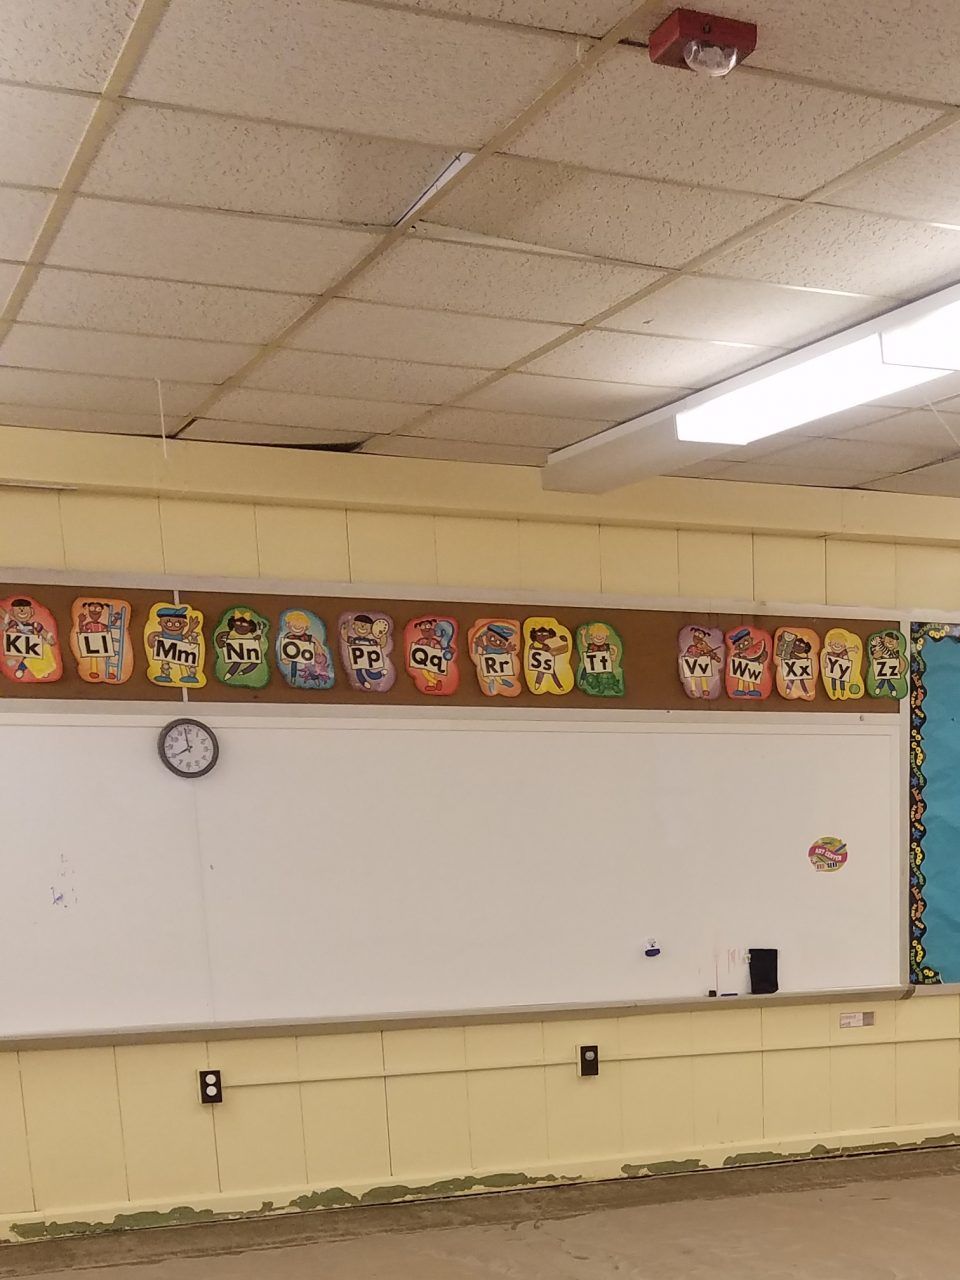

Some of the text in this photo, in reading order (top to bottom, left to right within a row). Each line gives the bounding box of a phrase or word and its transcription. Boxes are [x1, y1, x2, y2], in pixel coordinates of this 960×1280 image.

[5, 634, 42, 657] Kk
[83, 635, 111, 654] Ll
[156, 639, 198, 666] Mm
[226, 641, 260, 661] Nn
[282, 640, 314, 661] Oo
[352, 647, 381, 668] Pp
[411, 647, 446, 674] Qq
[485, 659, 511, 674] Rr
[530, 652, 553, 671] Ss
[586, 653, 608, 672] Tt
[684, 658, 710, 675] Vv
[732, 659, 762, 681] Ww
[784, 662, 811, 678] Xx
[828, 657, 851, 680] Yy
[876, 662, 899, 678] Zz
